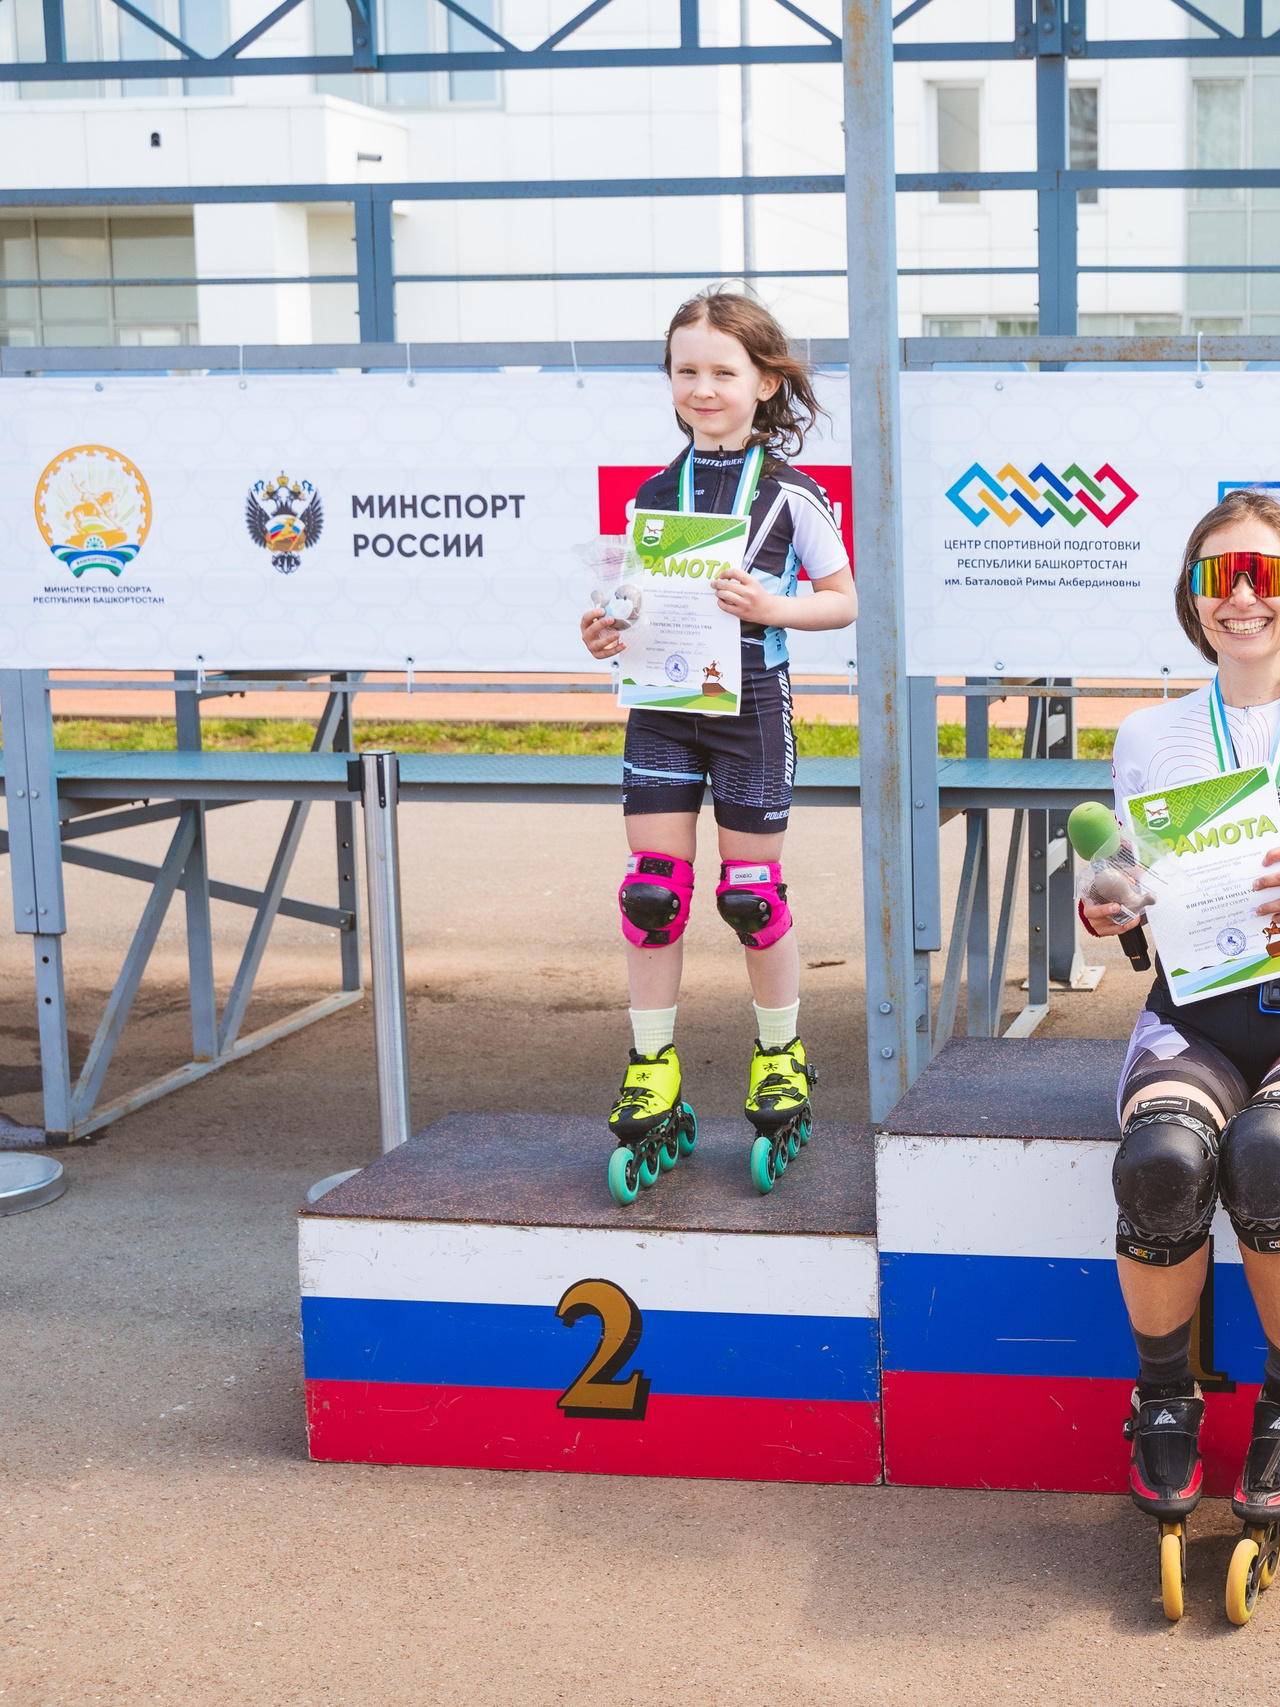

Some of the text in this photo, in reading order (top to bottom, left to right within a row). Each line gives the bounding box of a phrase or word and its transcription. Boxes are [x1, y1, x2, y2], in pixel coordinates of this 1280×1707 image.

[351, 494, 526, 519] МИНСПОРТ
[353, 533, 484, 558] РОССИИ
[944, 538, 1141, 551] ЦЕНТР СПОРТИВНОЙ ПОДГОТОВКИ
[641, 554, 733, 581] РАМОТА
[957, 558, 1127, 569] РЕСПУБЛИКИ БАШКОРТОСТАН
[944, 576, 1141, 588] им. Баталовой Римы Акбердиновны
[33, 596, 165, 604] РЕСПУБЛИКИ БАШКОРТОСТАН
[555, 1277, 652, 1421] 2
